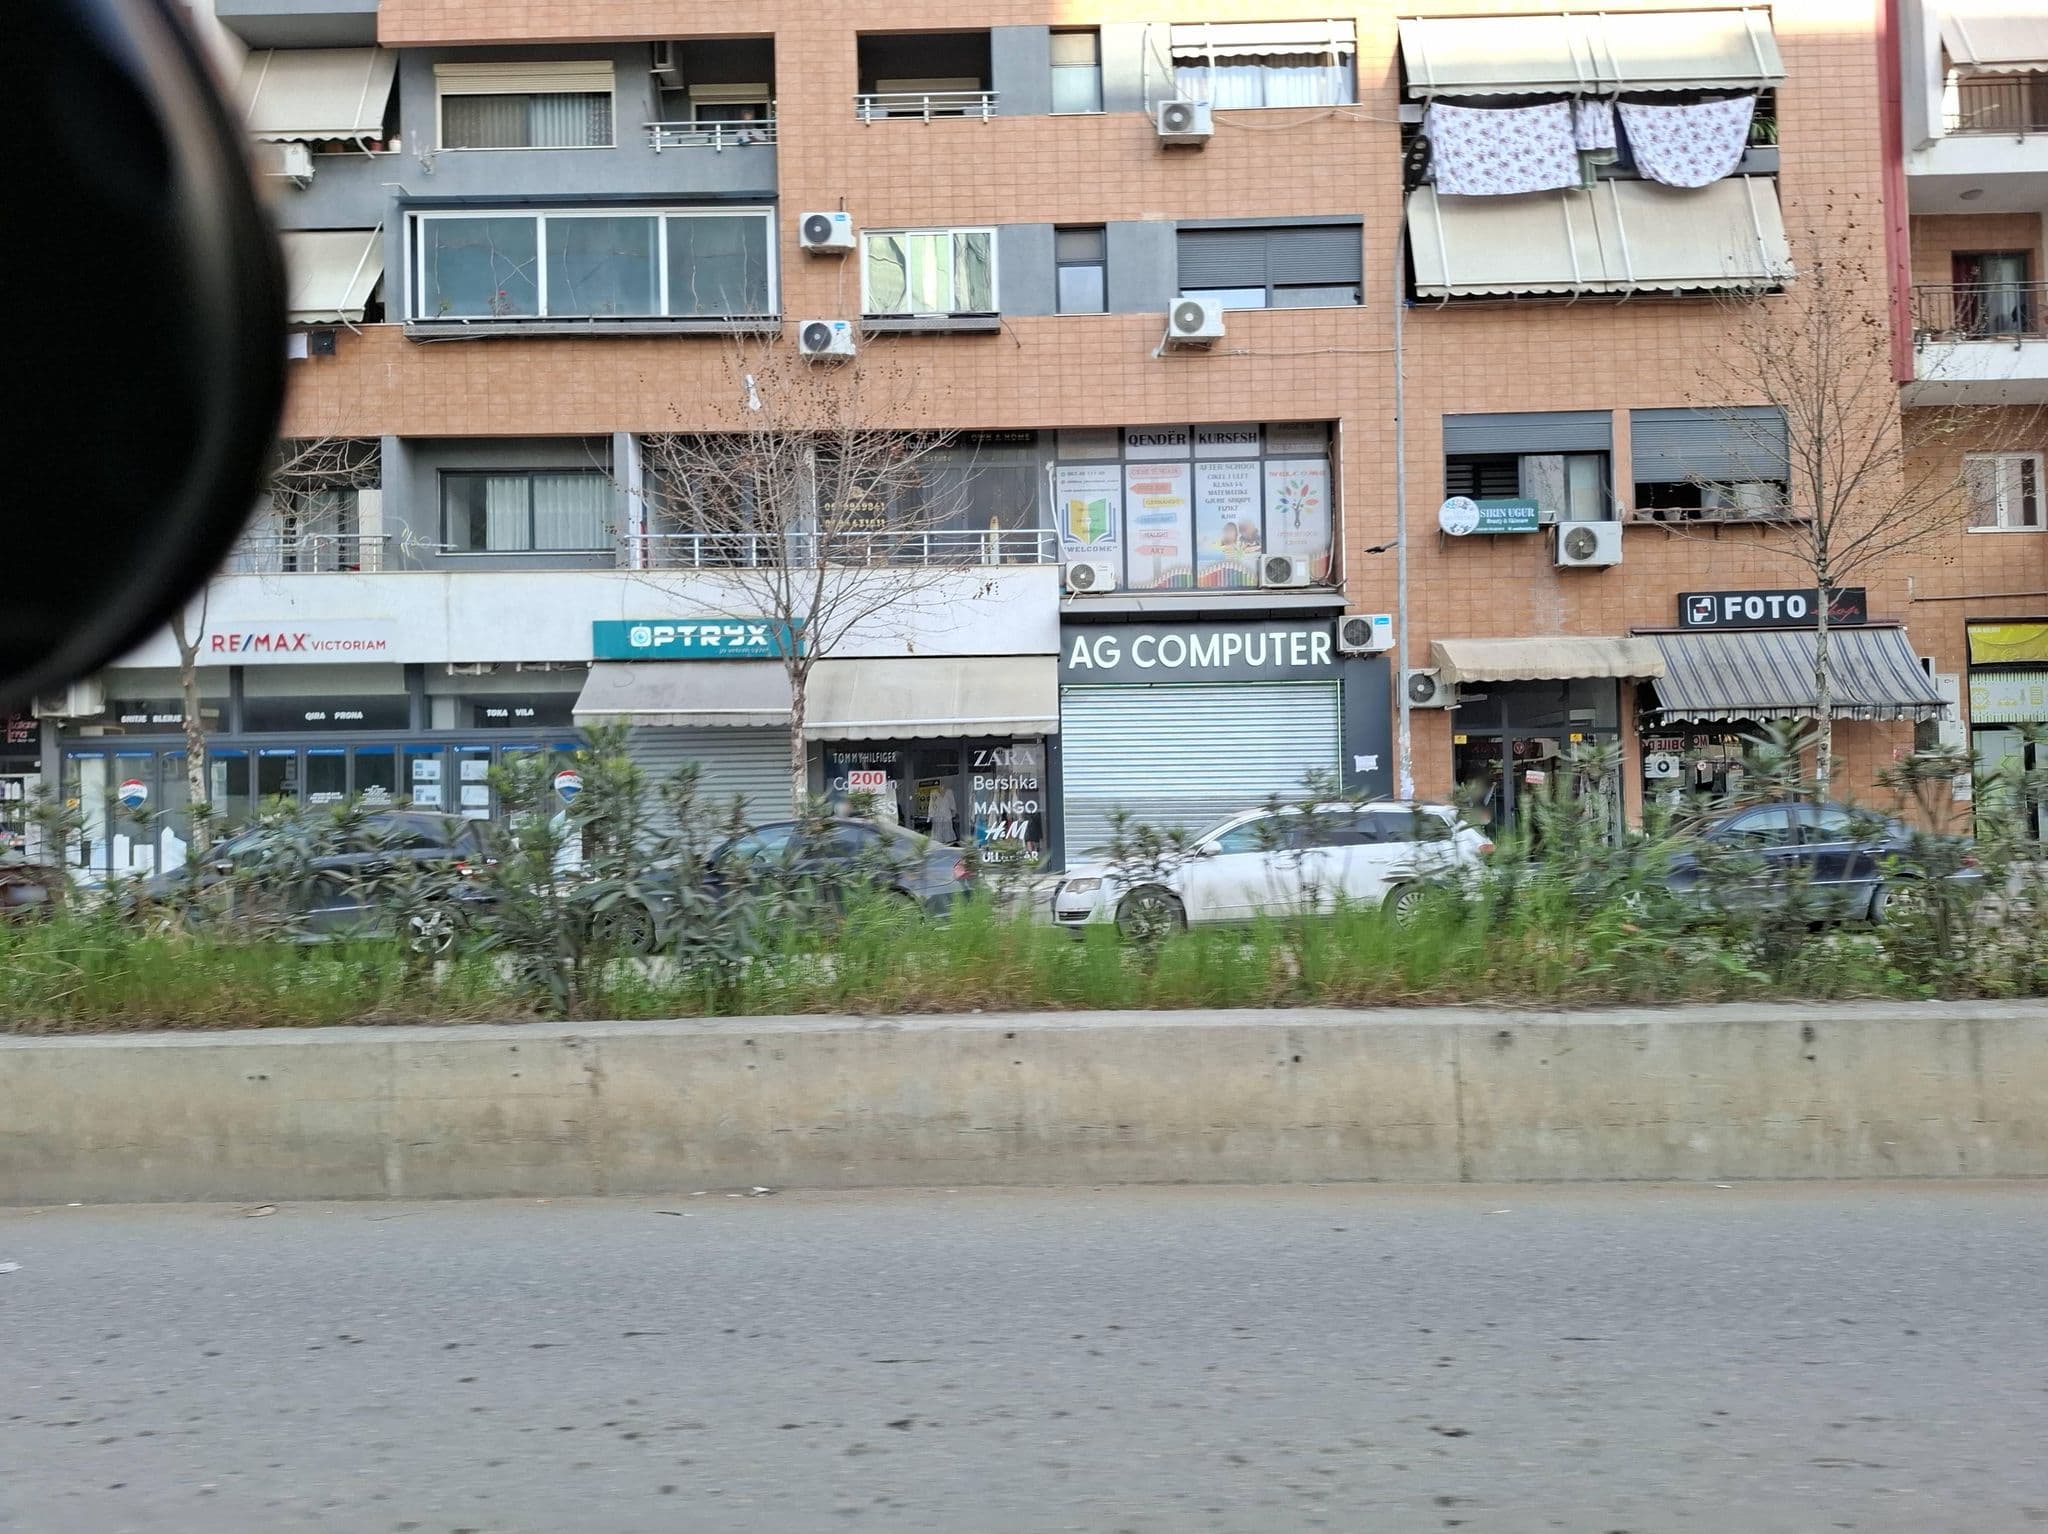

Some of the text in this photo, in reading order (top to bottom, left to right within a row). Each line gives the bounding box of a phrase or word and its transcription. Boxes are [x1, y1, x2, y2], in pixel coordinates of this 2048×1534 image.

[1128, 430, 1258, 447] QENDËR KURSESH
[1725, 596, 1807, 621] FOTO
[212, 633, 386, 652] RE/MAX VICTORIAM
[1068, 631, 1332, 669] AG COMPUTER
[973, 750, 1036, 767] ZARA
[851, 772, 884, 785] 200
[973, 775, 1038, 791] Bershka
[974, 801, 1039, 814] MANGO
[984, 820, 1029, 840] H&M
